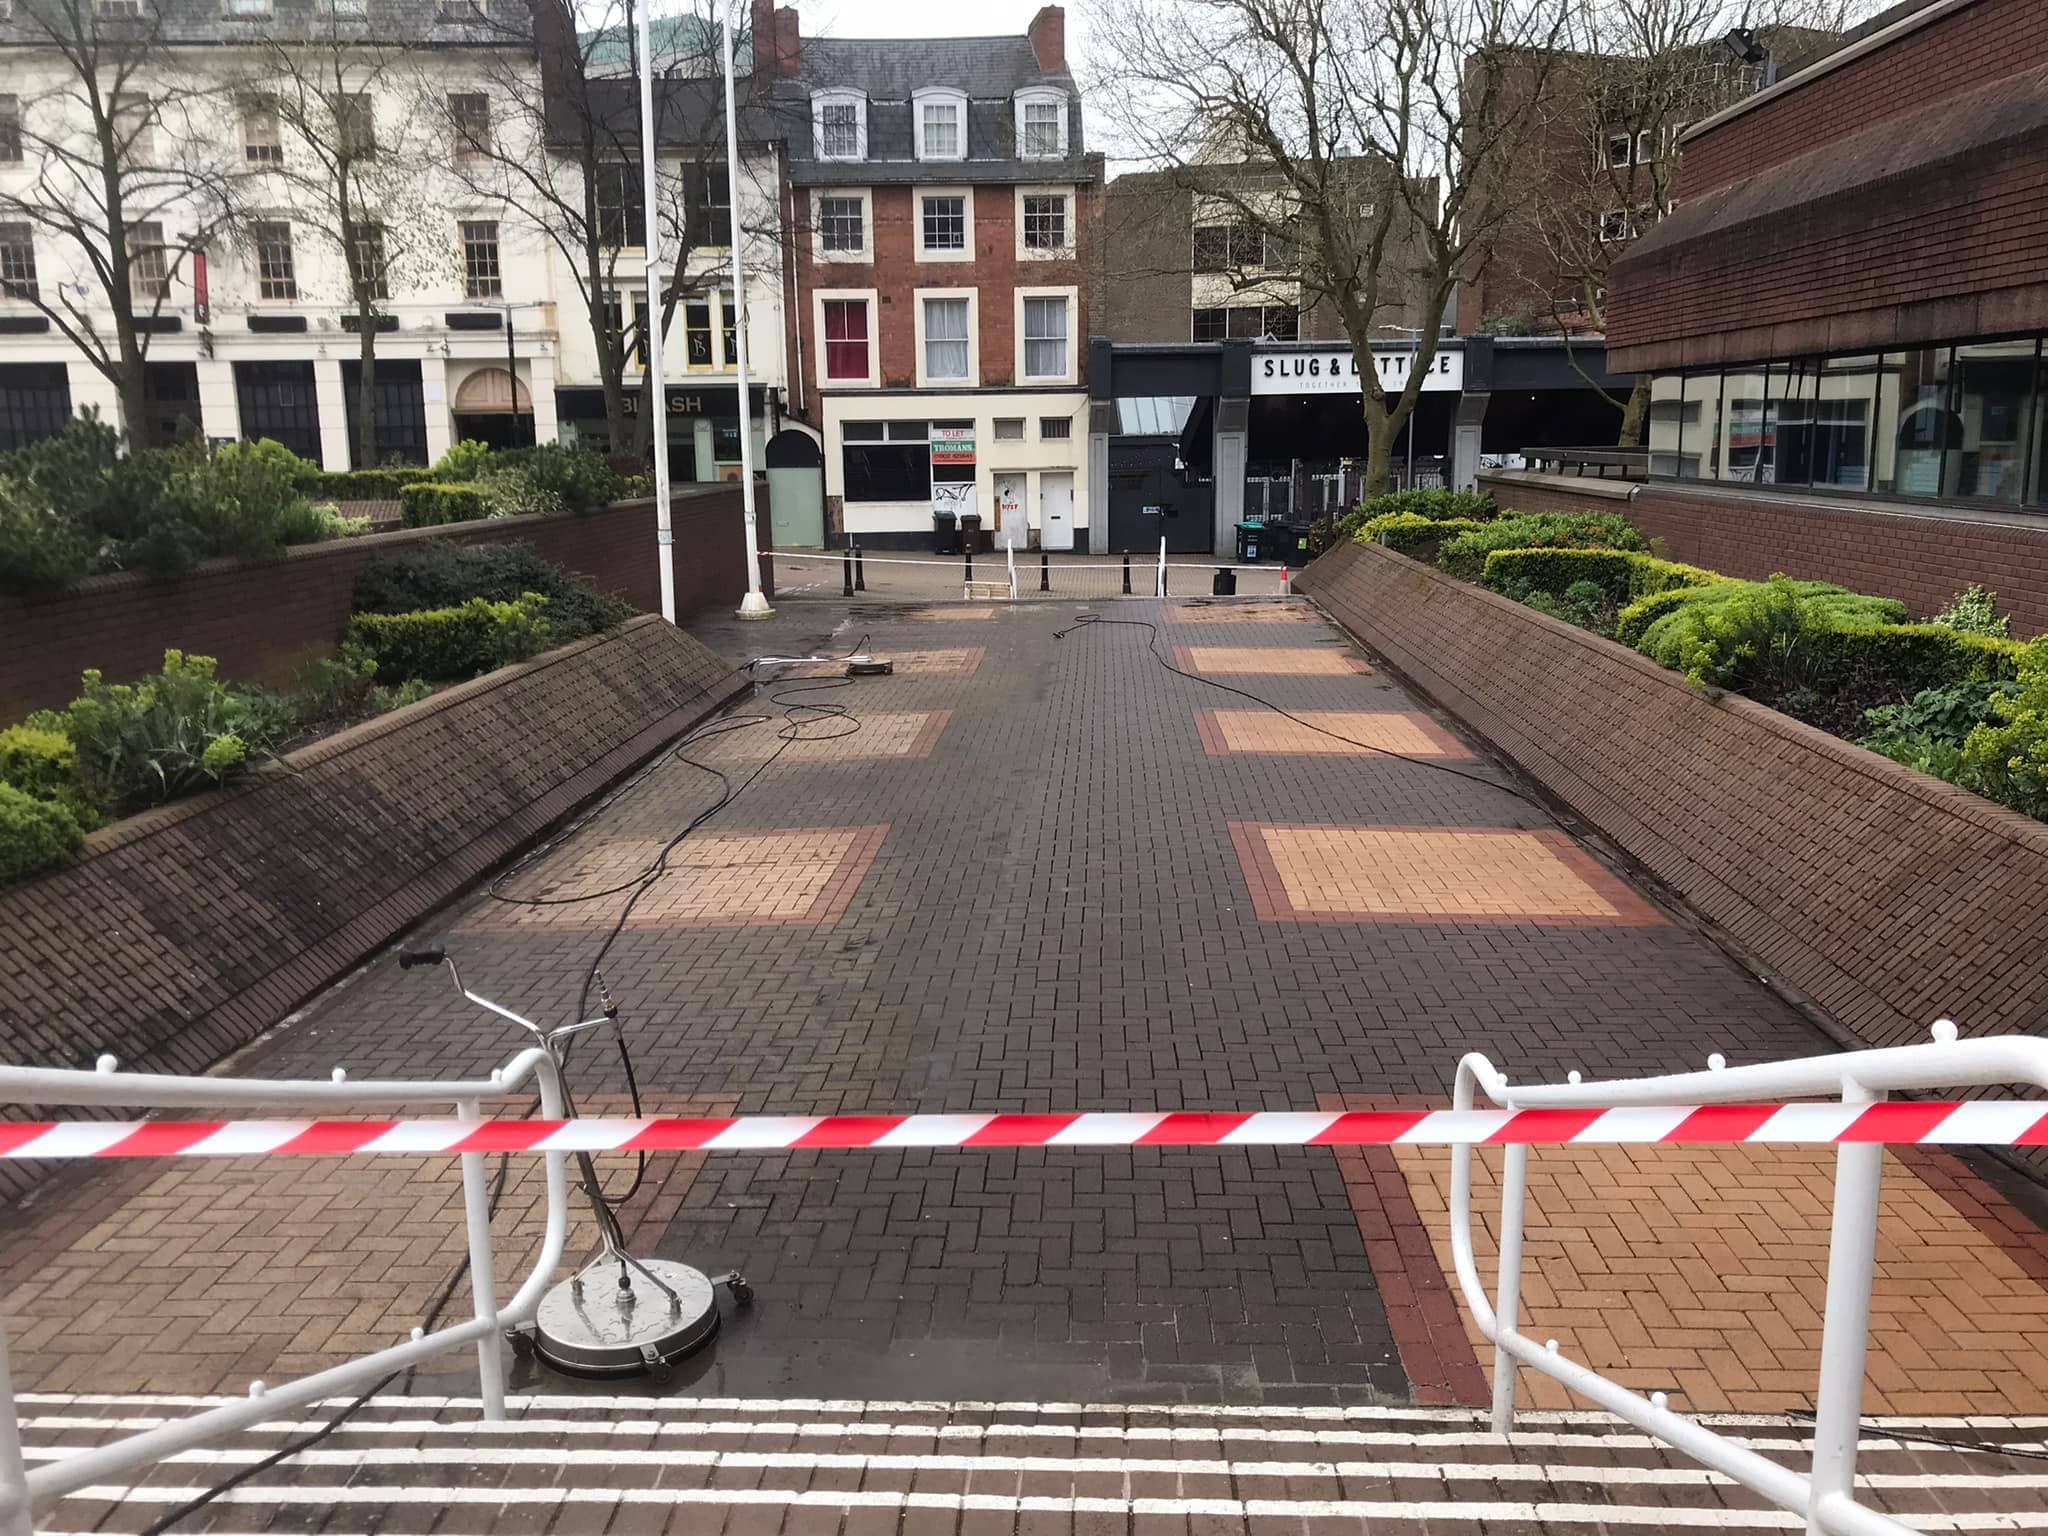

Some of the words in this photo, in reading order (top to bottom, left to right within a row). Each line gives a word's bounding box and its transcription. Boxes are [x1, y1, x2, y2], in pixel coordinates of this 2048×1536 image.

[1264, 358, 1320, 377] SLUG
[1330, 357, 1341, 376] &
[1351, 356, 1450, 375] LTTE
